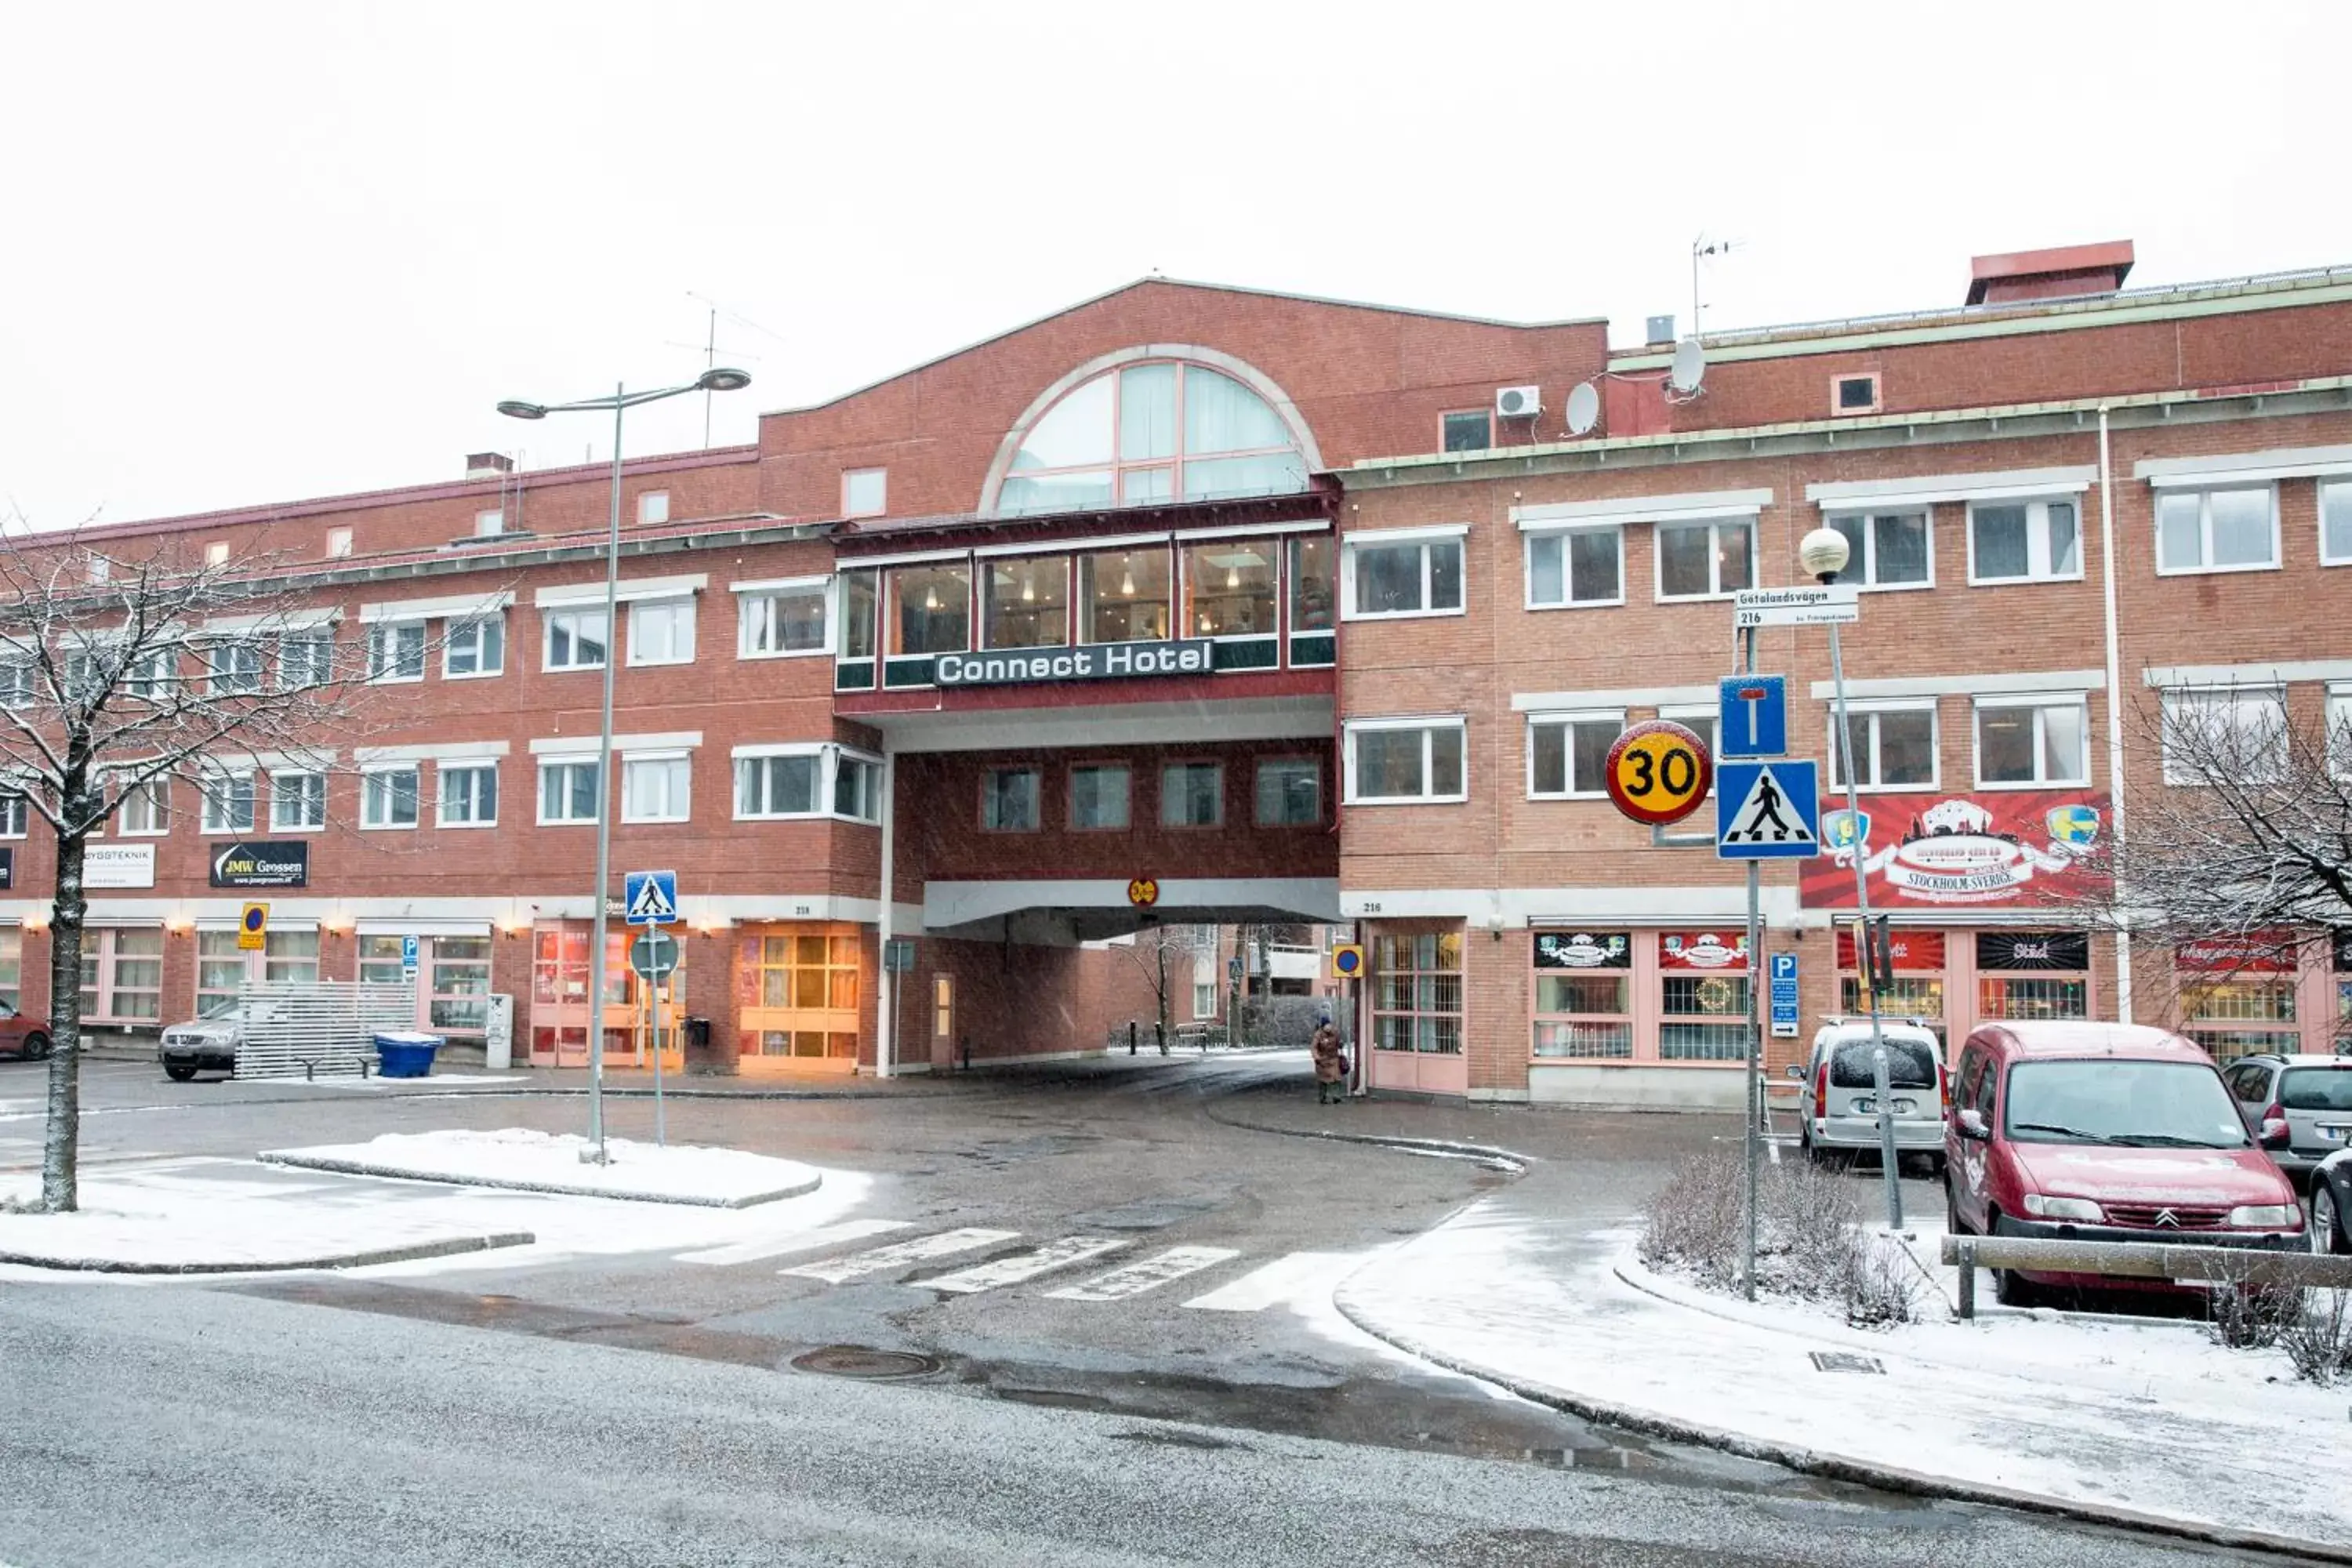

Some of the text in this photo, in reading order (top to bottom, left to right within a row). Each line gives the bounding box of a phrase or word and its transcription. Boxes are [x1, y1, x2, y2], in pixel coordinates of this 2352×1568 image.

[1740, 592, 1828, 604] Götalandsvägen
[1740, 612, 1761, 624] 216
[938, 643, 1210, 682] Connect Hotel
[1626, 748, 1695, 797] 30
[225, 860, 302, 873] JMW Grossen
[1363, 902, 1381, 913] 216
[1777, 957, 1793, 978] P
